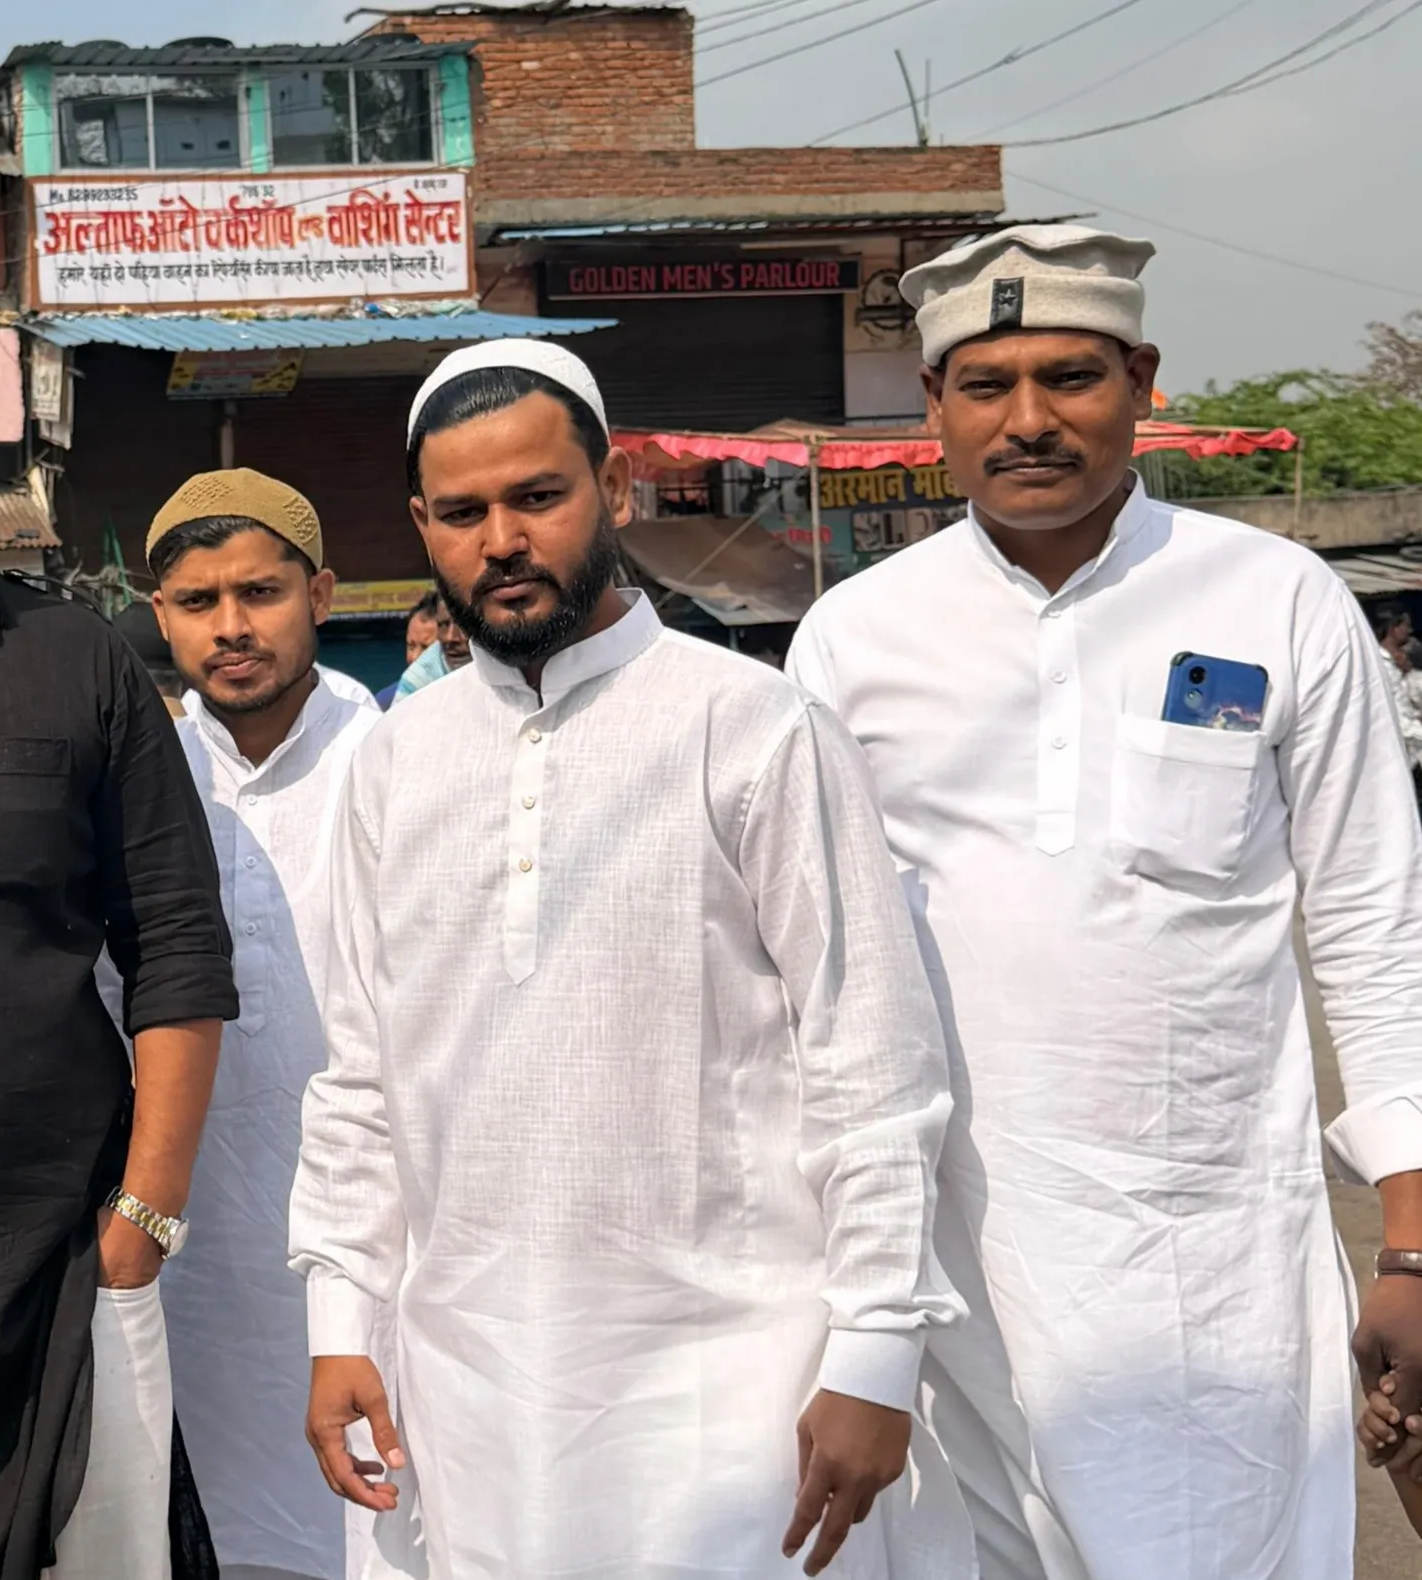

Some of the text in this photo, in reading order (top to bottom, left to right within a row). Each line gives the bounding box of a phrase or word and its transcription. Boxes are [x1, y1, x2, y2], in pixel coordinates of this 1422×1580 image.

[44, 211, 146, 255] अल्ताफ
[146, 196, 200, 253] ऑटो
[326, 187, 401, 248] वाशिंग
[403, 189, 462, 246] सेन्टर
[569, 261, 840, 292] GOLDEN MEN'S PARLOUR
[818, 468, 906, 508] अरमान
